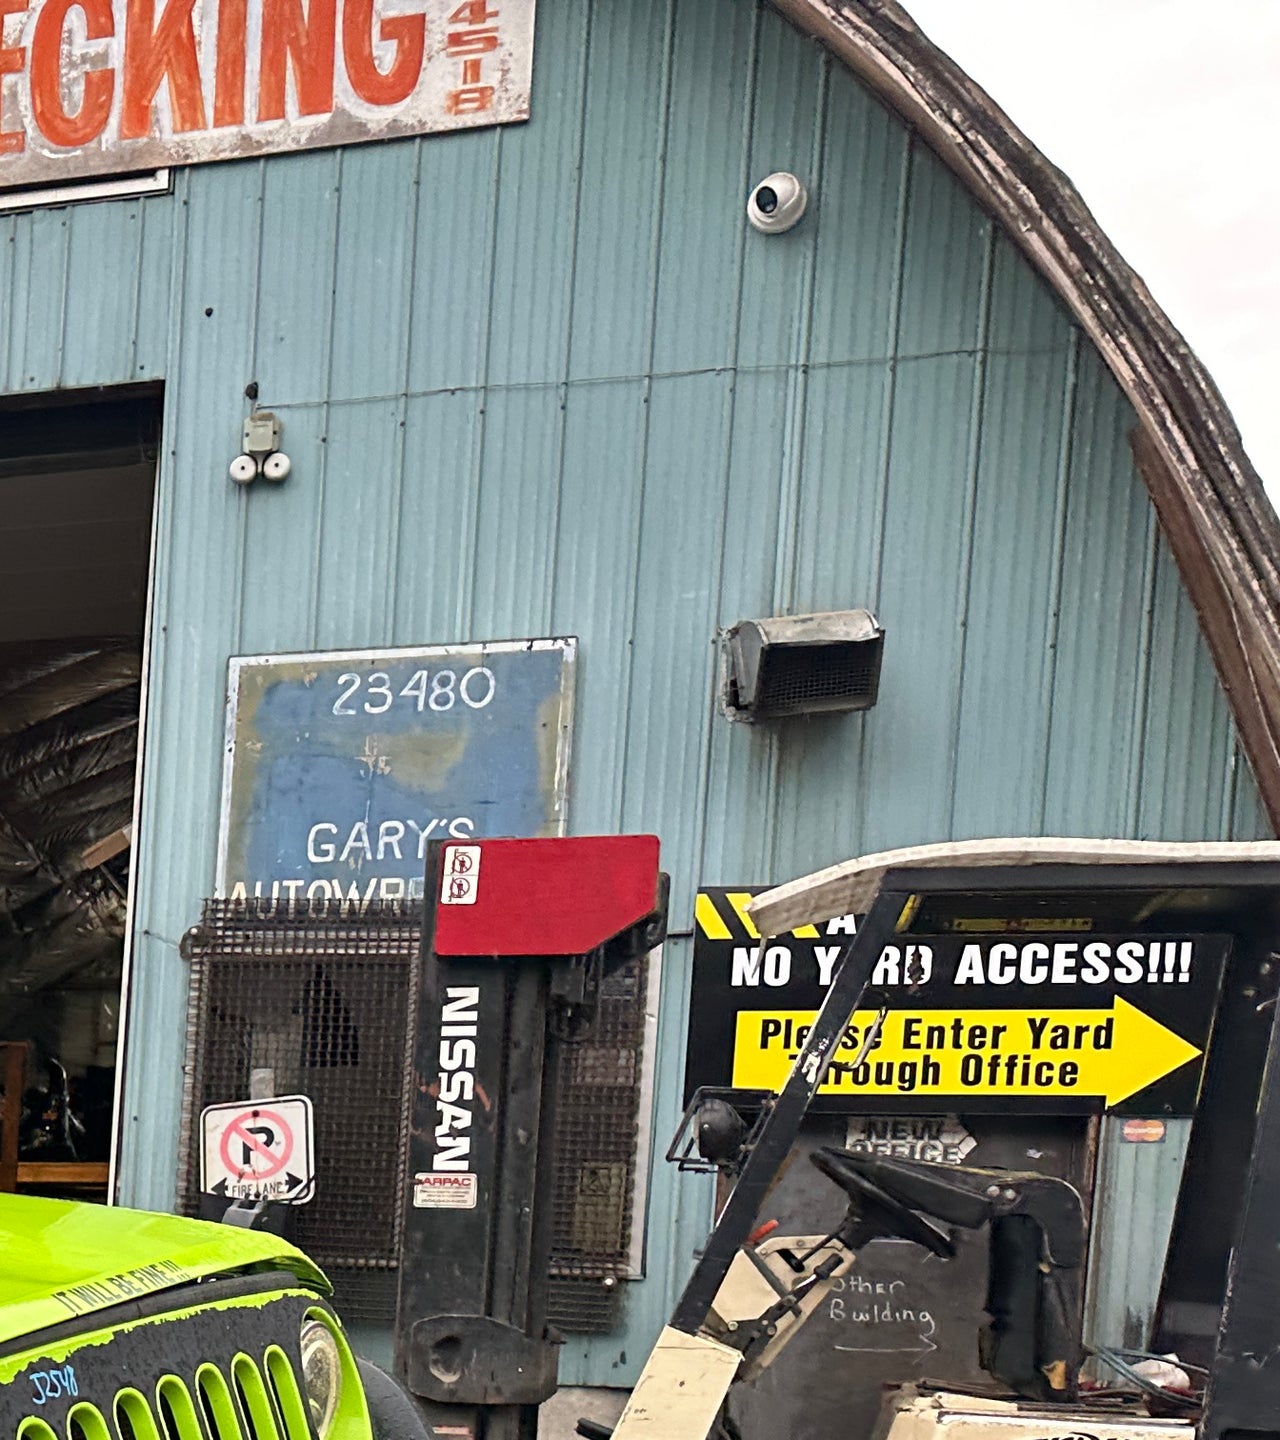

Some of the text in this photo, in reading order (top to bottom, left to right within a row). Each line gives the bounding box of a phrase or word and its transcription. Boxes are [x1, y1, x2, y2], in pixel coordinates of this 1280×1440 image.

[331, 667, 496, 715] 23480
[307, 817, 475, 863] GARY'S
[231, 877, 424, 918] AUTOWR
[731, 942, 1193, 987] NO YRD ACCESS!!!
[760, 1018, 1114, 1050] Plese Enter Yard
[433, 985, 480, 1171] NISSAN
[788, 1053, 1079, 1092] rough Office
[68, 1281, 122, 1307] WILL
[105, 1274, 145, 1297] BE
